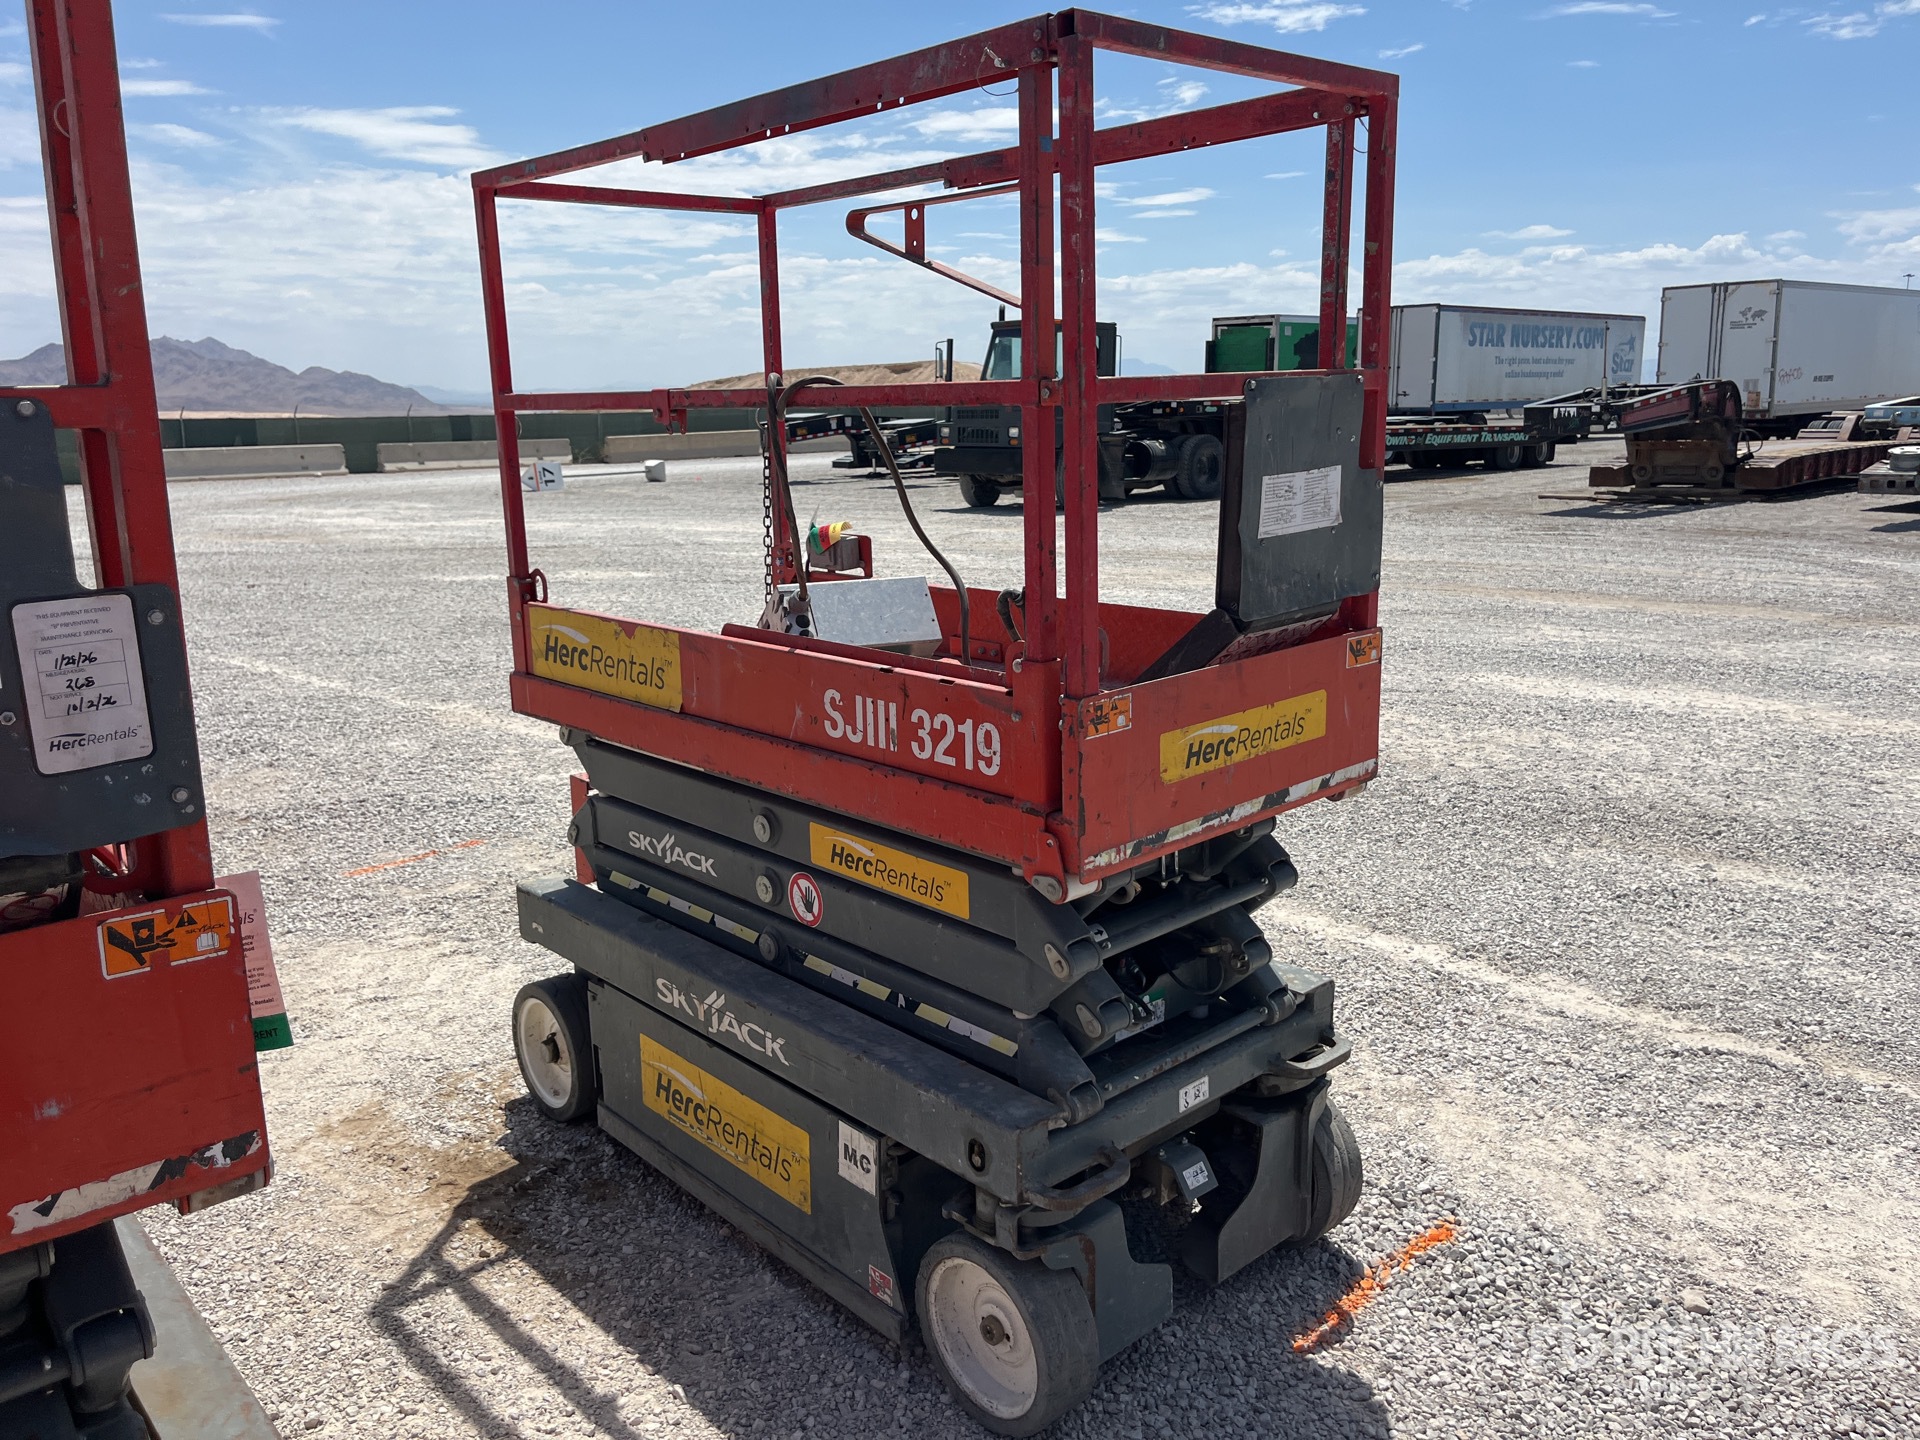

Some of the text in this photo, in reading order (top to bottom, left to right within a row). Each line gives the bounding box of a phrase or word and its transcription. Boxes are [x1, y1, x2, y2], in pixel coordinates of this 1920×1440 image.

[1468, 321, 1604, 350] STAR NURSERY.COM
[1612, 352, 1634, 375] Star
[542, 466, 556, 487] 17
[49, 609, 82, 619] EQUIPMENT
[83, 606, 111, 614] RECEIVED
[40, 628, 113, 642] MAINTENANCE SERVICING
[910, 707, 1001, 776] 3219
[628, 829, 718, 878] SKYJACK
[655, 977, 790, 1067] SKYJACK
[843, 1142, 872, 1174] MC
